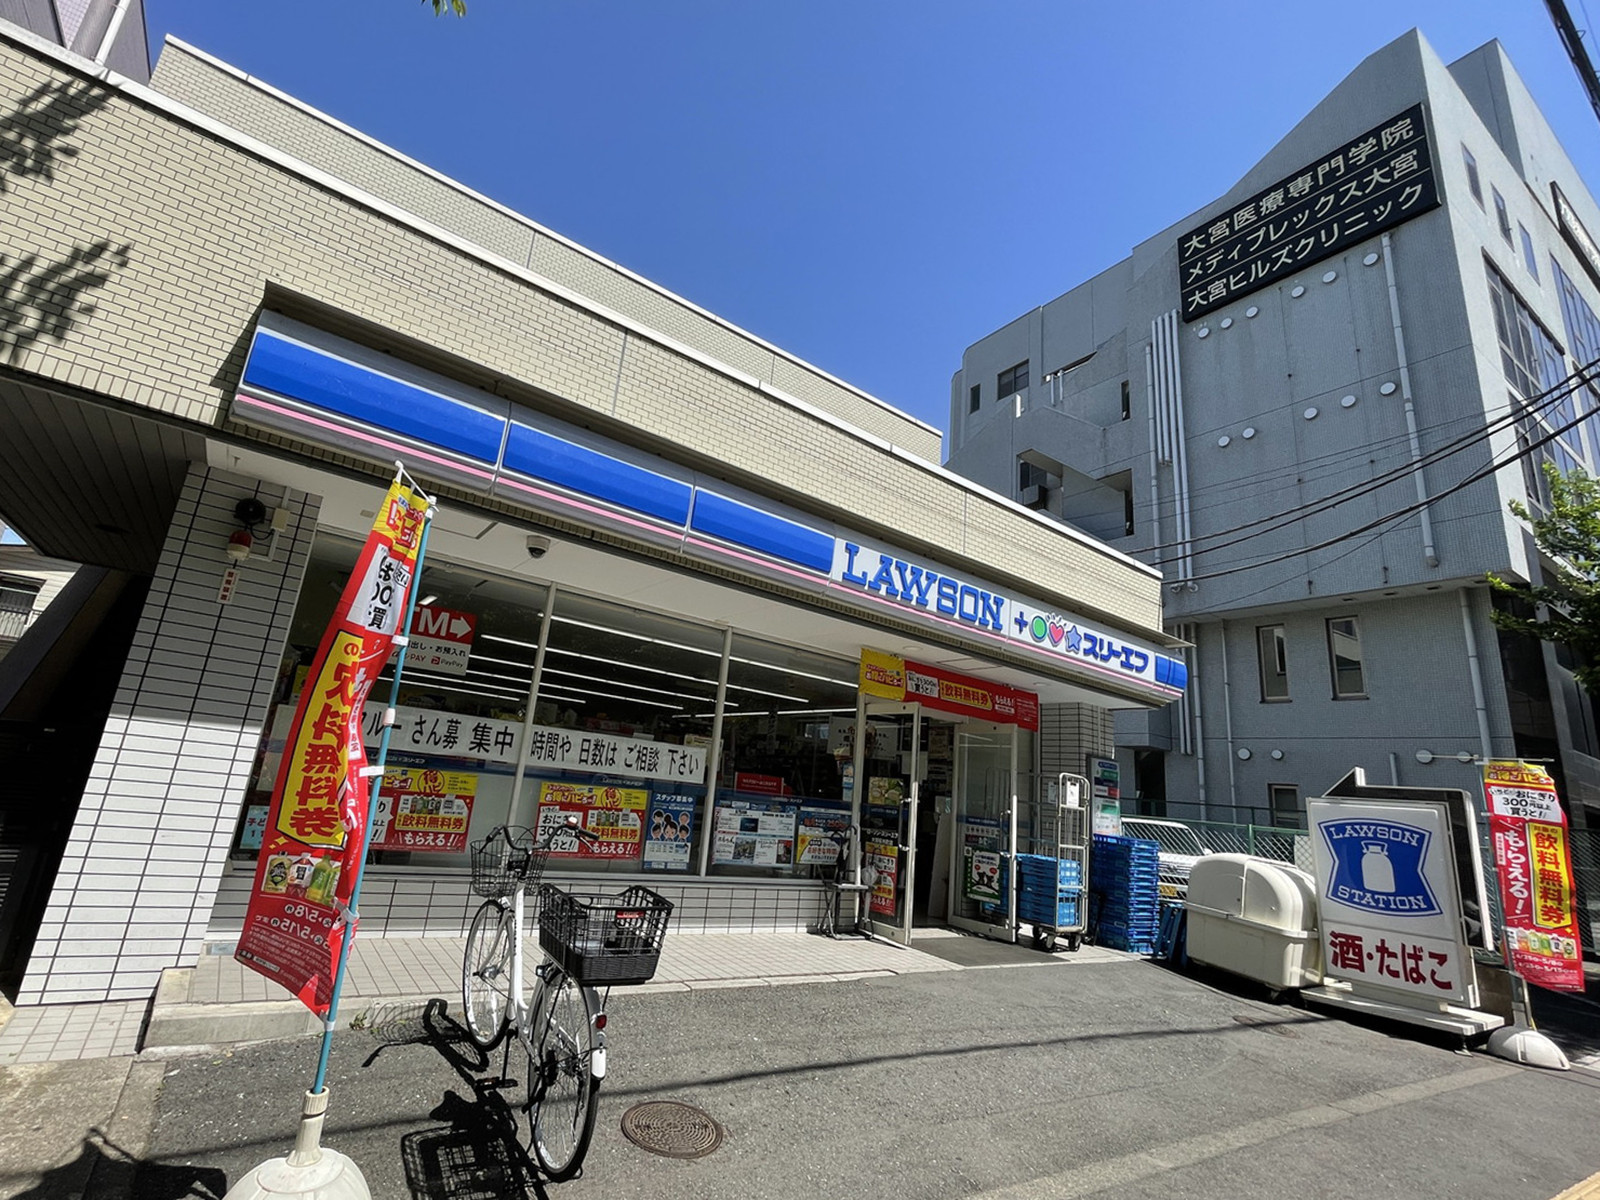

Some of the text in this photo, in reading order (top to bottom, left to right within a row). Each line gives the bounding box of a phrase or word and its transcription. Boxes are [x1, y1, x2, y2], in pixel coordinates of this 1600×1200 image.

[1183, 117, 1414, 258] 大宮医療専門学院
[1187, 149, 1419, 284] メディプレックス大宮
[1188, 183, 1423, 312] 大宮ヒルズクリニック
[843, 542, 1004, 631] LAWSON
[1083, 634, 1149, 673] スリーエフ
[402, 814, 465, 830] 飲料無料券
[655, 793, 693, 803] スタッフ募集中
[1329, 825, 1420, 847] LAWSON
[1337, 885, 1427, 910] STATION
[1534, 831, 1565, 926] 飲料無料券
[1329, 930, 1453, 990] 酒・たばこ
